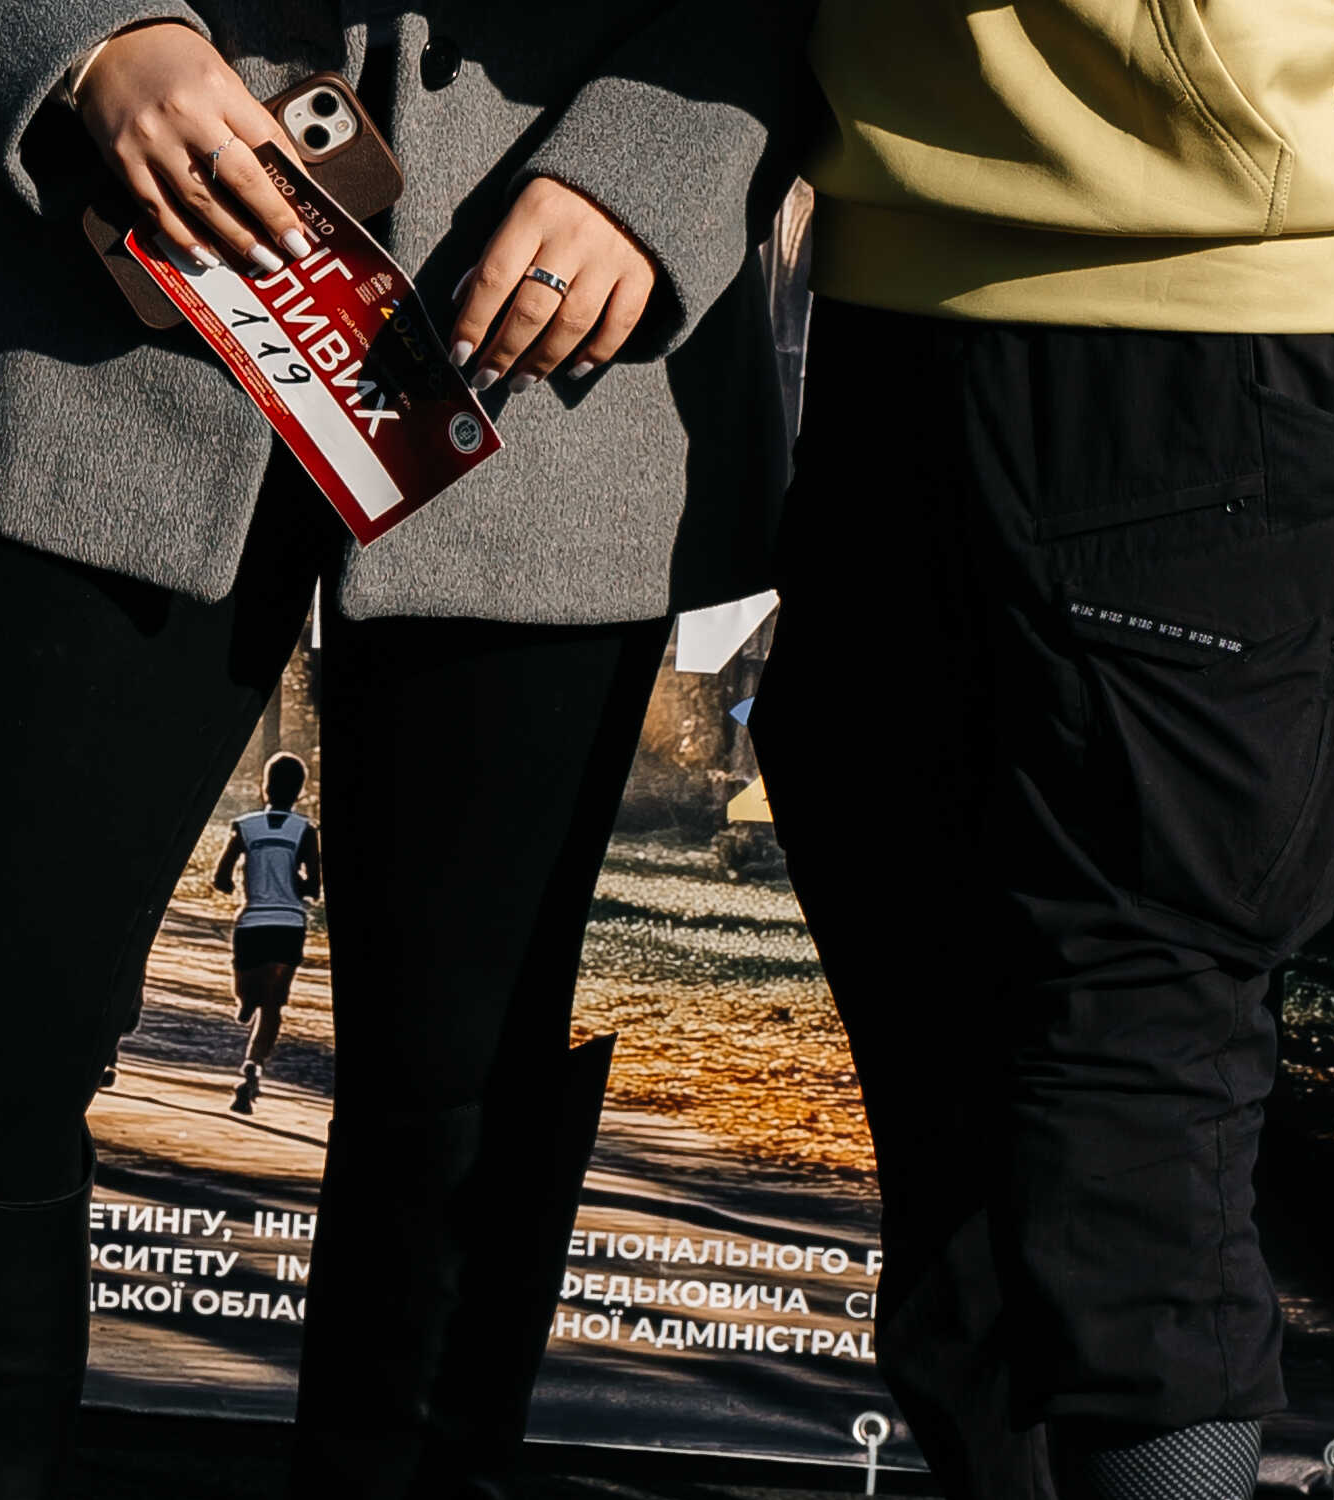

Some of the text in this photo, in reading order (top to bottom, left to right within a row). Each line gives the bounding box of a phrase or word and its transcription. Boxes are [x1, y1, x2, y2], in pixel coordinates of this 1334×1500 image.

[264, 162, 336, 236] 11:00 23.10
[231, 308, 311, 385] 119
[250, 264, 400, 438] ЛИВИХ
[89, 1203, 233, 1242] ЕТИНГУ,
[254, 1210, 318, 1241] ІНН
[568, 1230, 848, 1275] ЕГІОНАЛЬНОГО
[89, 1243, 239, 1277] СИТЕТУ
[90, 1280, 185, 1313] ЬКОЇ
[192, 1289, 307, 1321] ОБЛА
[550, 1308, 621, 1341] НОЇ
